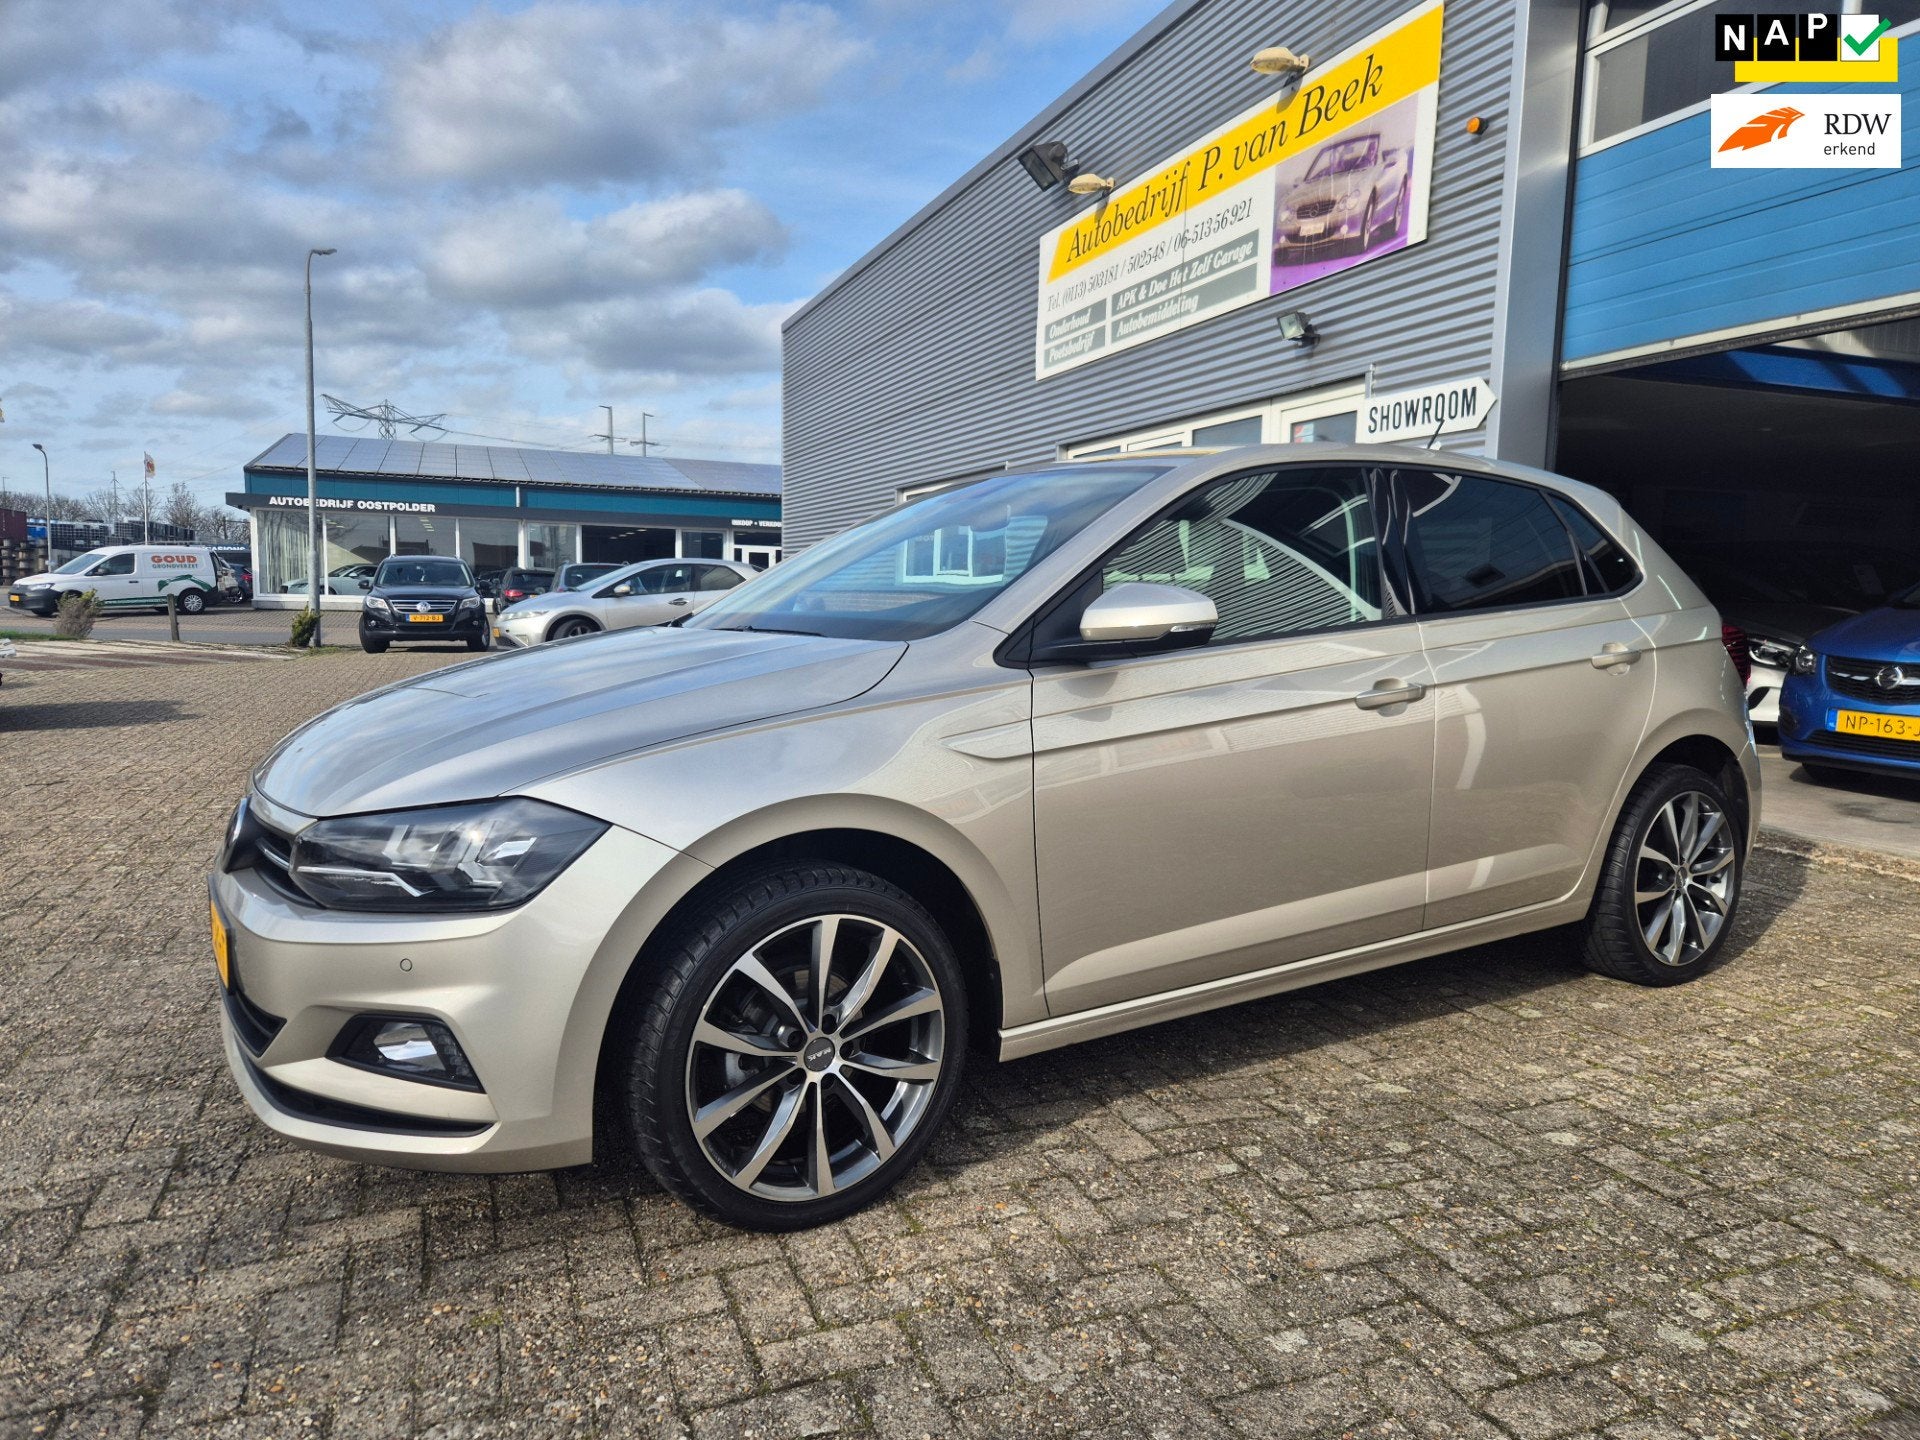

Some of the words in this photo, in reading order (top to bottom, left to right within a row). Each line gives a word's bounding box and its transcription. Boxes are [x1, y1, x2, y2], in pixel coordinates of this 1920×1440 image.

[1066, 160, 1190, 263] Autobedrijf
[1198, 146, 1224, 191] P.
[1234, 119, 1288, 171] van
[1295, 54, 1384, 139] Beek
[1062, 278, 1087, 307] (0113)
[1088, 264, 1119, 293] 503181
[1127, 240, 1166, 274] 502548
[1116, 287, 1138, 311] APK
[1138, 284, 1147, 301] &
[1148, 279, 1168, 298] Doe
[1168, 266, 1189, 288] Het
[1188, 253, 1214, 280] Zelf
[1213, 241, 1254, 270] Garage
[1049, 308, 1092, 339] Onderhoud
[1367, 386, 1477, 434] SHOWROOM
[357, 500, 436, 512] OOSTPOLDER
[151, 555, 197, 563] GOUD
